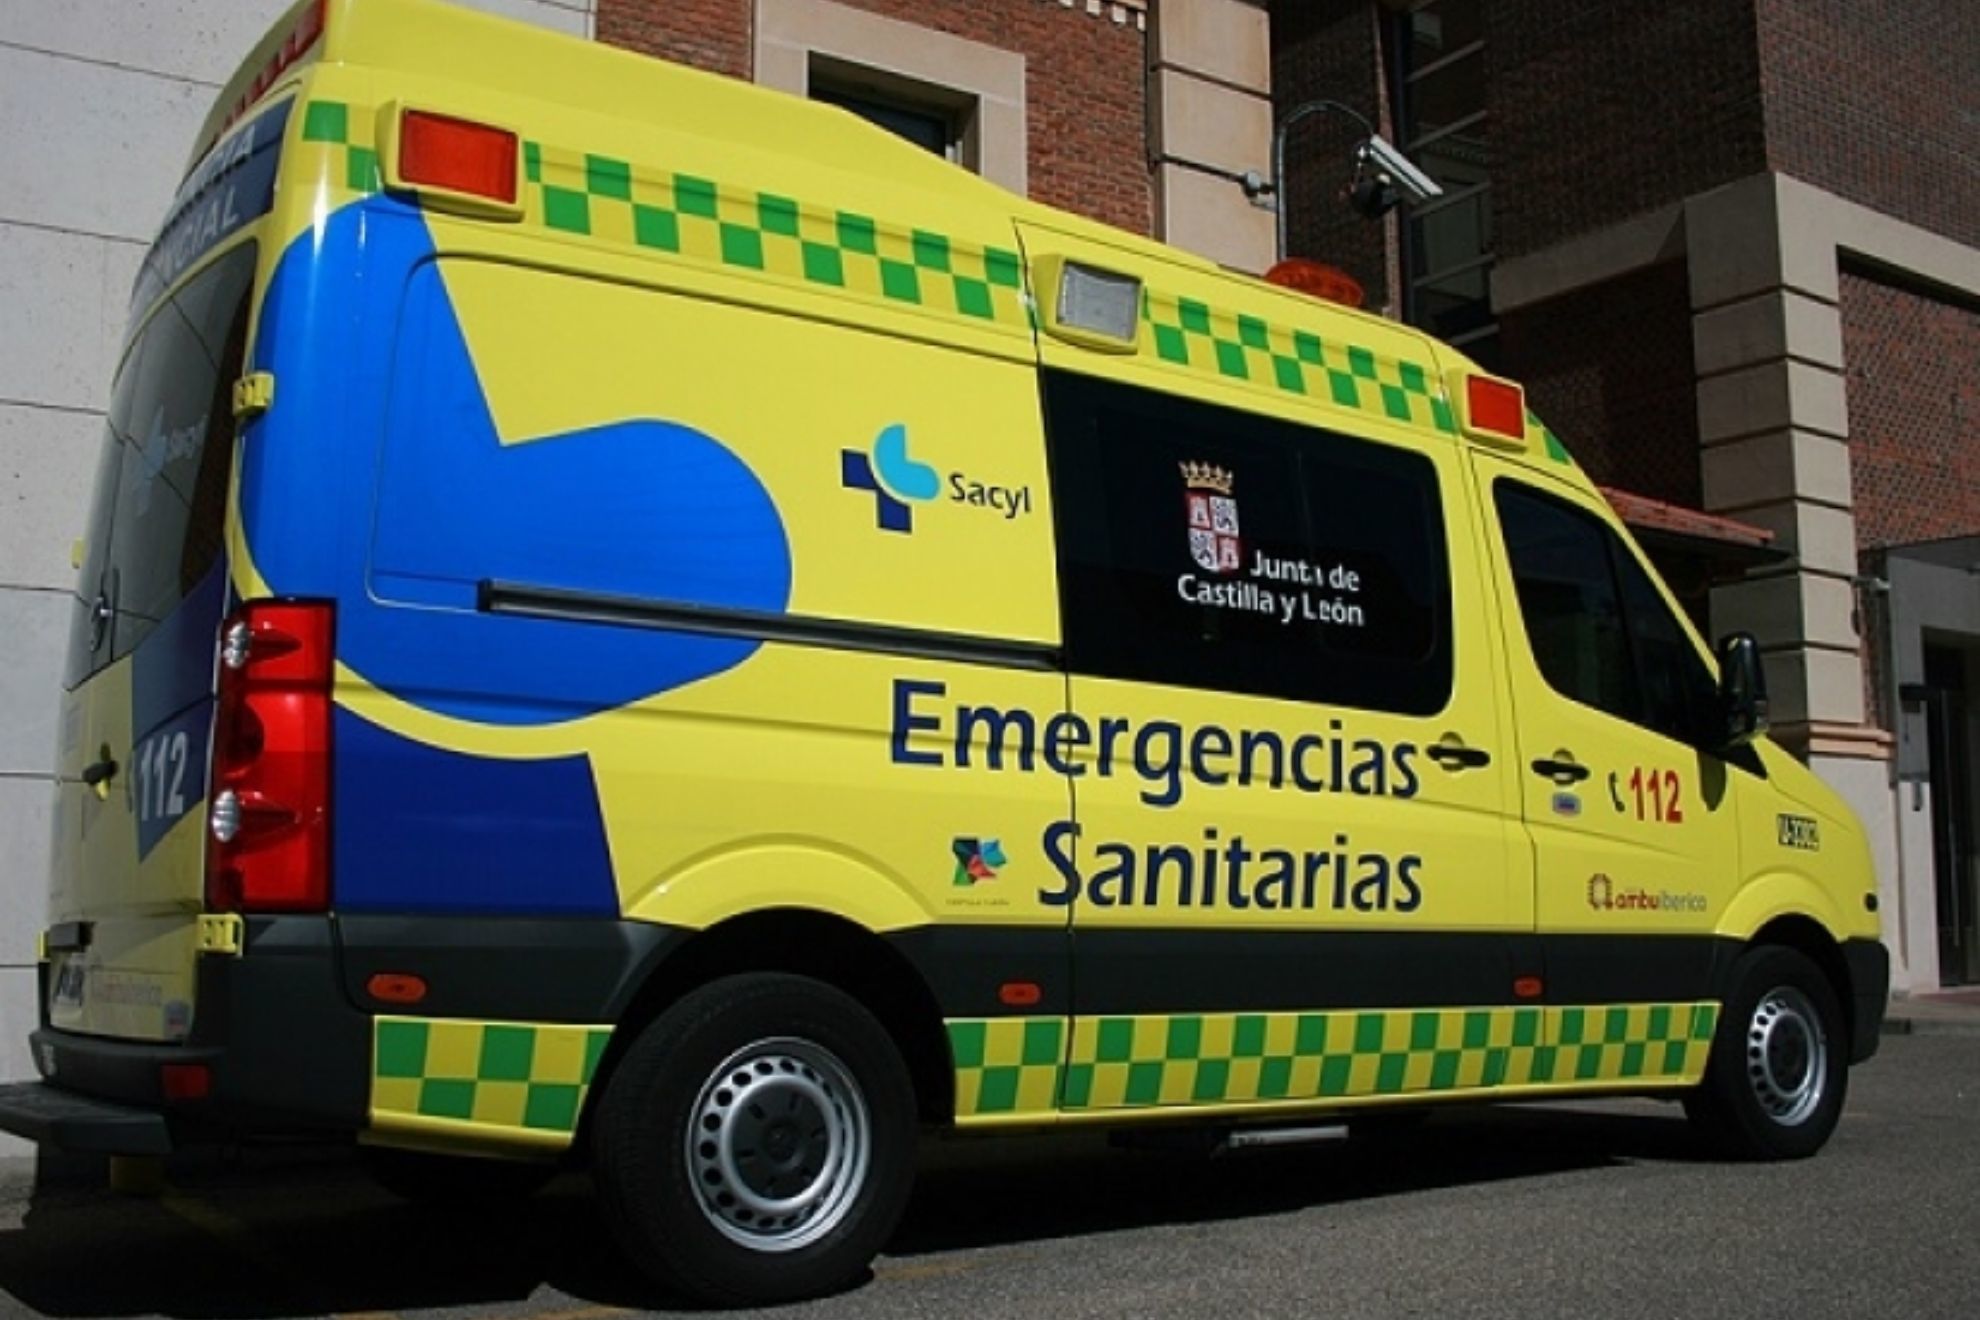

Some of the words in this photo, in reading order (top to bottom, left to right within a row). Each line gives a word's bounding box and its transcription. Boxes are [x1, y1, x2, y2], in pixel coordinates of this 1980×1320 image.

[949, 473, 1031, 519] Sacyl
[1178, 573, 1275, 614] Castilla
[1279, 594, 1297, 624] y
[1302, 591, 1364, 627] León
[1328, 563, 1360, 592] de
[891, 678, 1420, 806] Emergencias
[139, 731, 188, 822] 112
[1630, 766, 1683, 823] 112
[1038, 821, 1422, 912] Sanitarias
